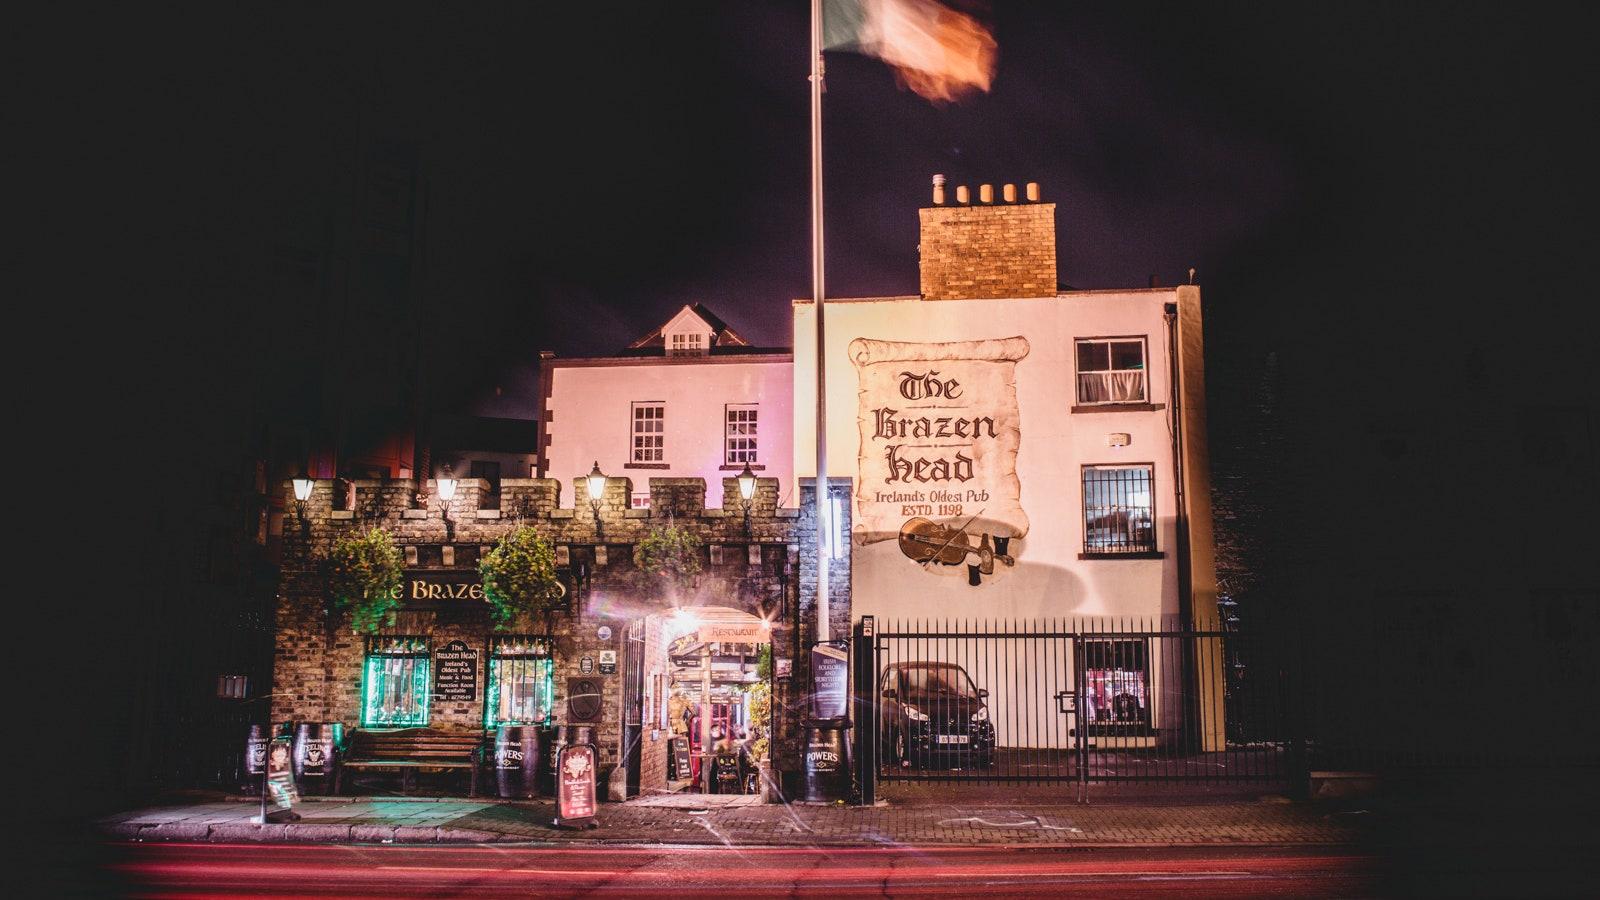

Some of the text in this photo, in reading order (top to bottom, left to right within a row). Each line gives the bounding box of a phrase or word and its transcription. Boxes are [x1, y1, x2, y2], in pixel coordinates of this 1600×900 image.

[898, 369, 964, 400] The
[871, 406, 1000, 442] Brazen
[875, 488, 990, 503] Ireland's Oldest Pub
[938, 504, 963, 516] 1198
[412, 580, 491, 603] BRAZE
[806, 751, 838, 762] POWERS
